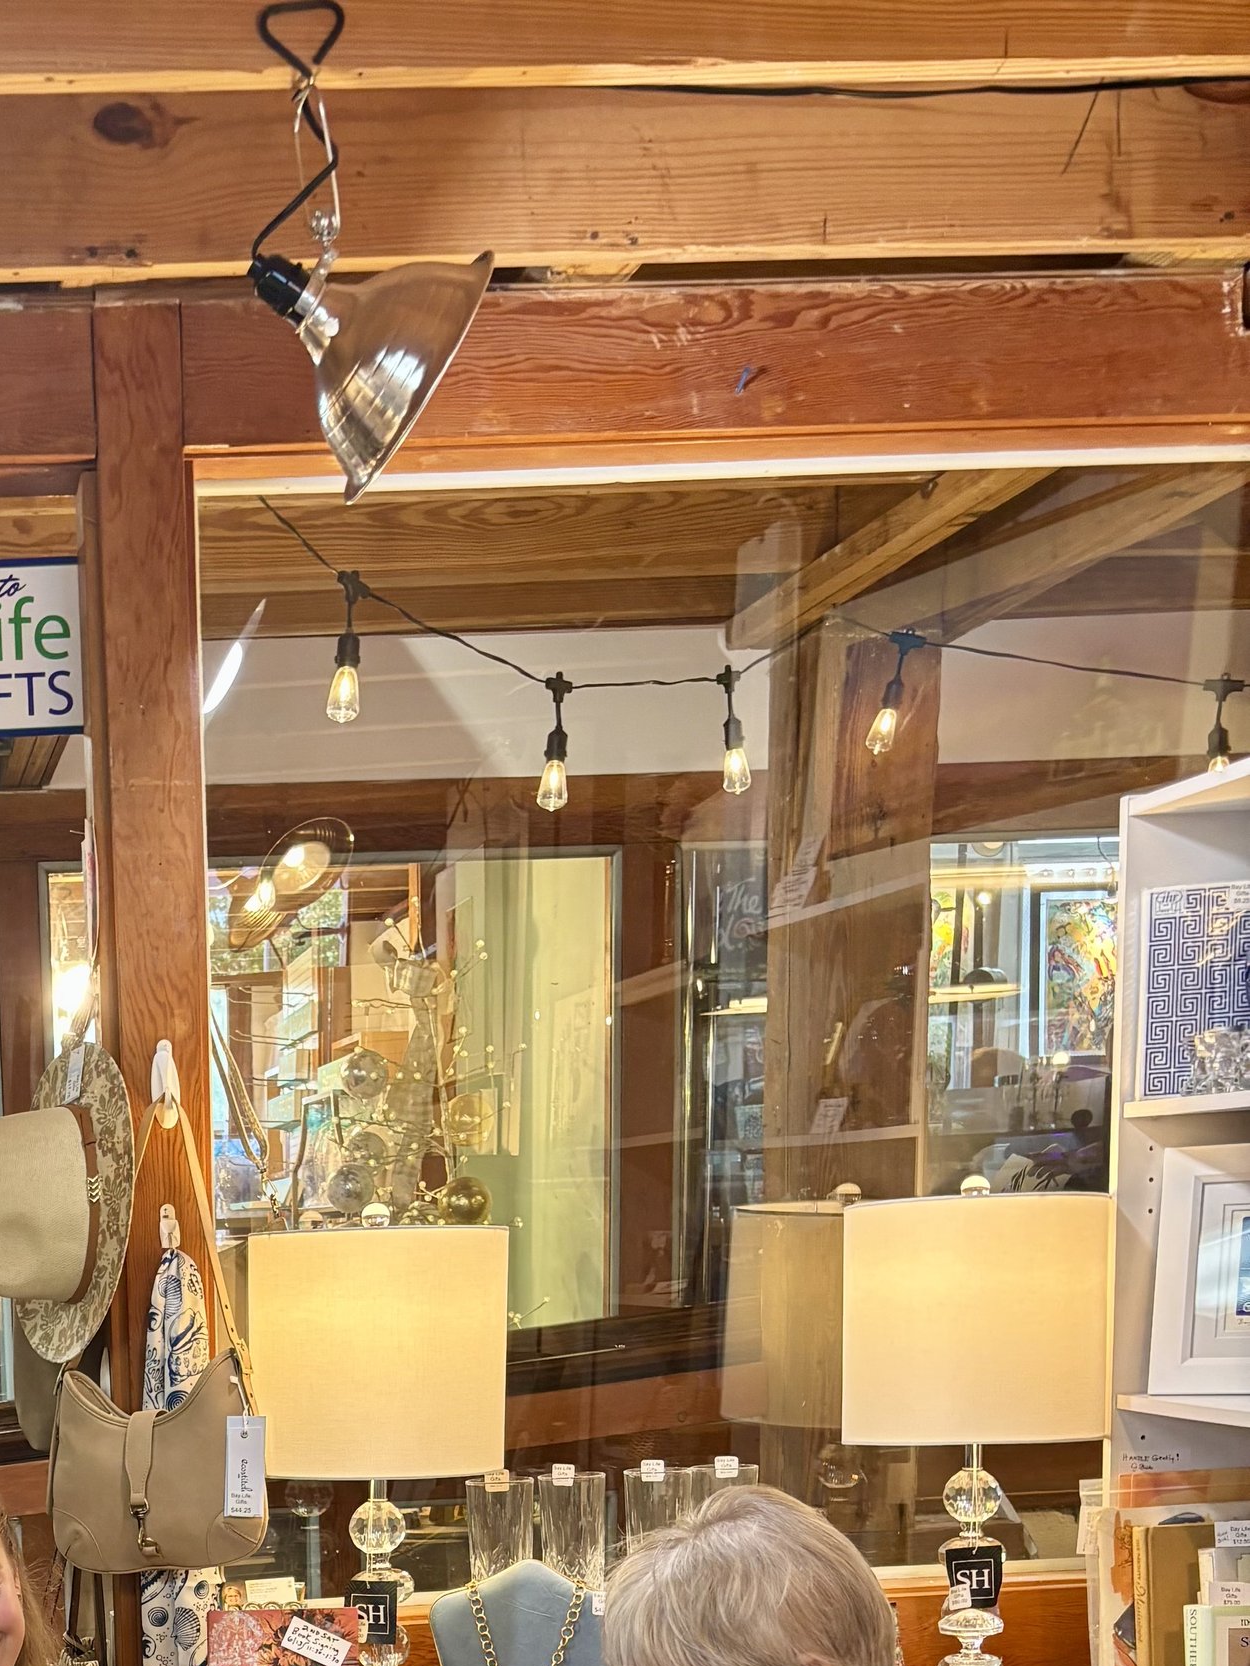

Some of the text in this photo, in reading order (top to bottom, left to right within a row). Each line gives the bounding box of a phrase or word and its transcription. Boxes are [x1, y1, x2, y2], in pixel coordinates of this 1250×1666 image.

[956, 1568, 990, 1589] SH
[355, 1603, 386, 1625] SH
[291, 1626, 311, 1642] Book
